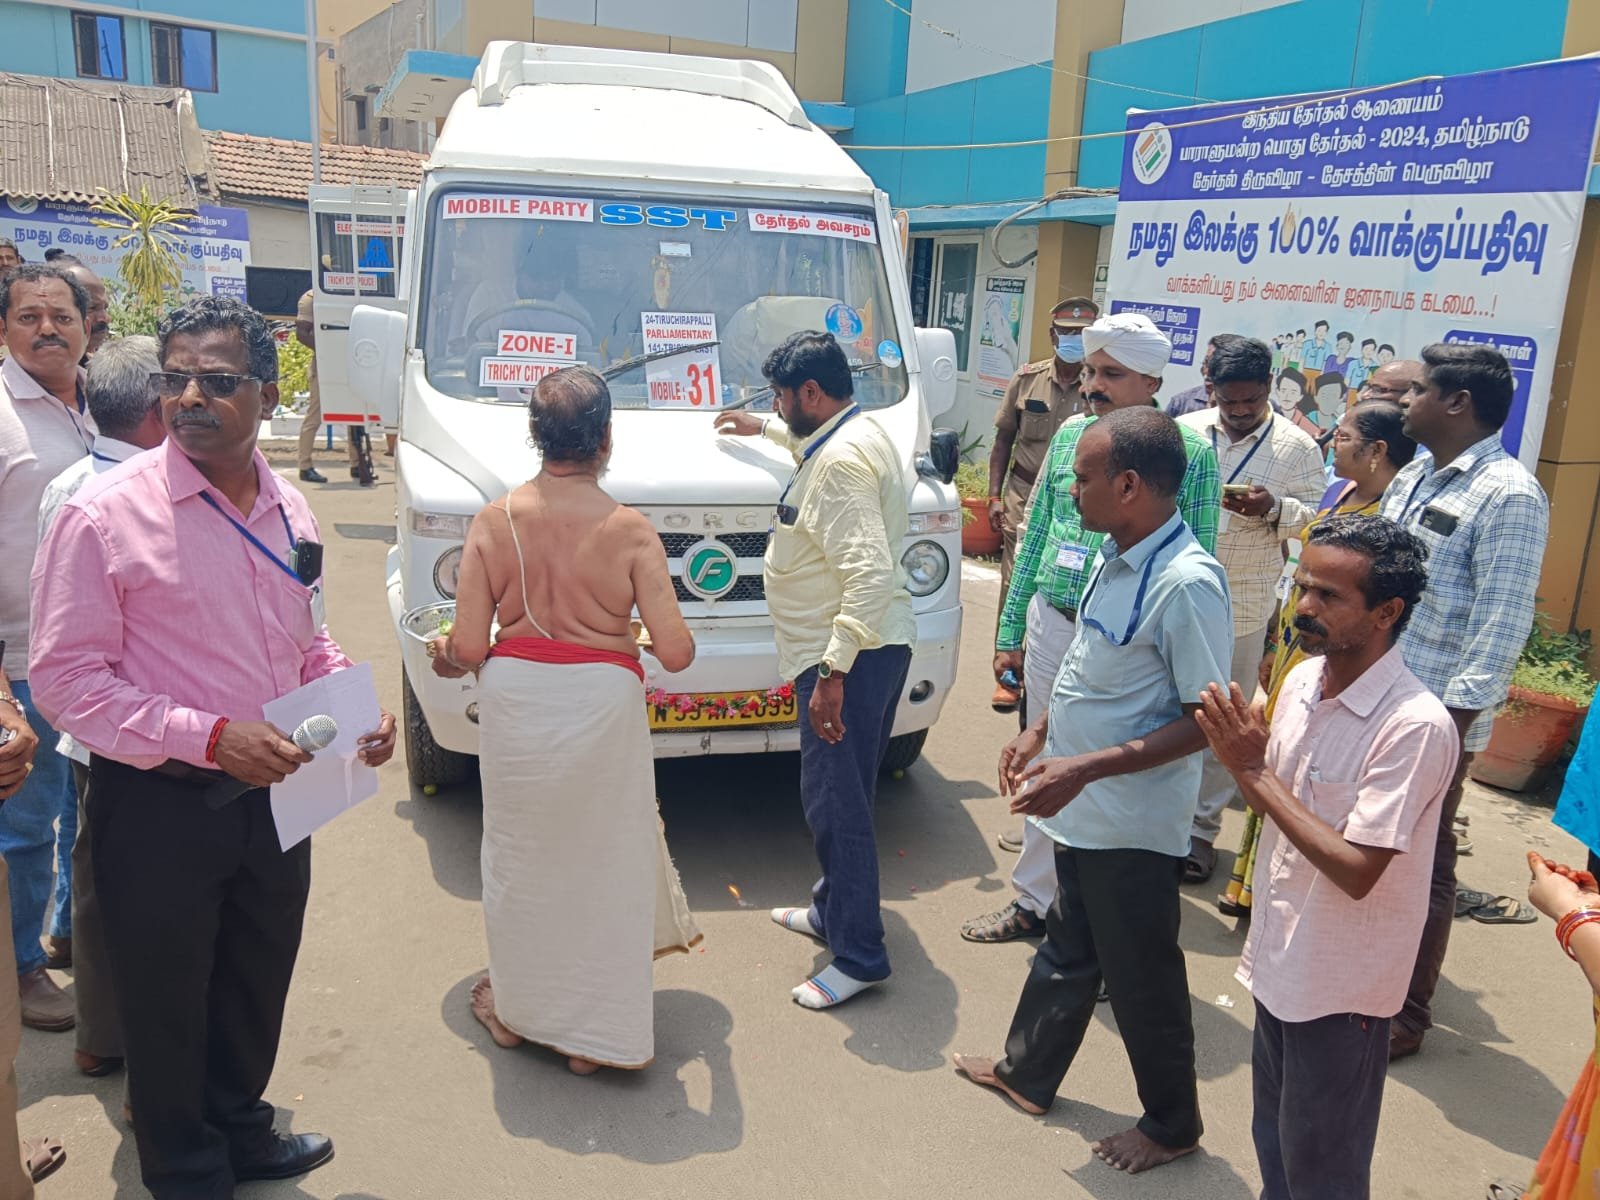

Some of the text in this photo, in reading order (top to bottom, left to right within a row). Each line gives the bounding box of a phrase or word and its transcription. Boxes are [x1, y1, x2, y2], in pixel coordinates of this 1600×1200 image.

[1242, 85, 1444, 132] இந்திய தேர்தல் ஆணையம்
[1180, 136, 1261, 162] பாராளுமன்ற
[1263, 137, 1307, 161] பொது
[1309, 126, 1367, 157] தேர்தல்
[1379, 125, 1430, 149] 2024,
[1431, 115, 1531, 150] தமிழ்நாடு
[1192, 169, 1238, 191] தேர்தல்
[1240, 168, 1303, 191] திருவிழா
[1320, 160, 1398, 188] தேசத்தின்
[1402, 158, 1494, 185] பெருவிழா
[447, 199, 588, 217] MOBILE PARTY
[600, 203, 737, 231] SST
[14, 227, 52, 248] நமது
[58, 227, 109, 250] இலக்கு
[755, 213, 872, 238] தேர்தல் அவசரம்
[1127, 206, 1549, 276] நமது இலக்கு 100% வாக்குப்பதிவு
[1166, 273, 1236, 303] வாக்களிப்பது
[1237, 276, 1258, 302] நம்
[1261, 279, 1341, 305] அனைவரின்
[1344, 286, 1416, 314] ஜனநாயக
[645, 314, 712, 326] 24-TIRUCHIRAPPALLI
[501, 334, 574, 355] ZONE-I
[646, 328, 712, 340] PARLIAMENTARY
[488, 363, 521, 382] TRICHY
[524, 364, 545, 382] CITY
[650, 381, 681, 401] MOBILE
[687, 363, 716, 406] 31
